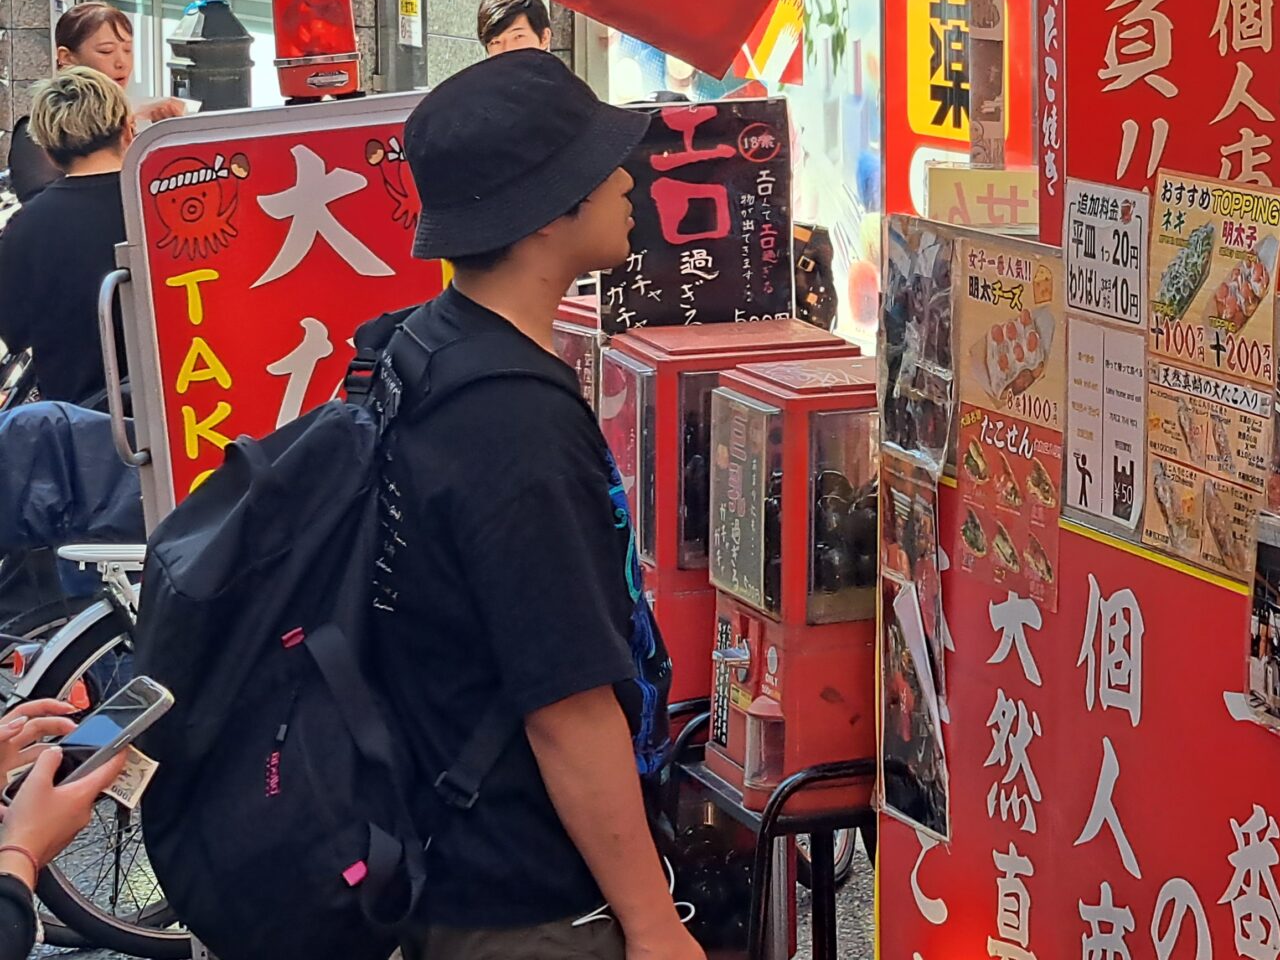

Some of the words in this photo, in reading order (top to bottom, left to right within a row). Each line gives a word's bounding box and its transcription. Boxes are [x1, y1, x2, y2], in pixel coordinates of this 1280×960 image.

[1077, 192, 1119, 221] 追加料金
[1161, 179, 1211, 210] おすすめ
[1161, 209, 1186, 234] ネギ
[1222, 220, 1257, 249] 明太子
[1071, 220, 1096, 259] 平皿
[1112, 228, 1139, 269] 20円
[969, 275, 1024, 311] 明太チーズ
[1069, 264, 1100, 307] わりばし
[1112, 275, 1139, 318] 10円
[980, 415, 1033, 460] たこせん
